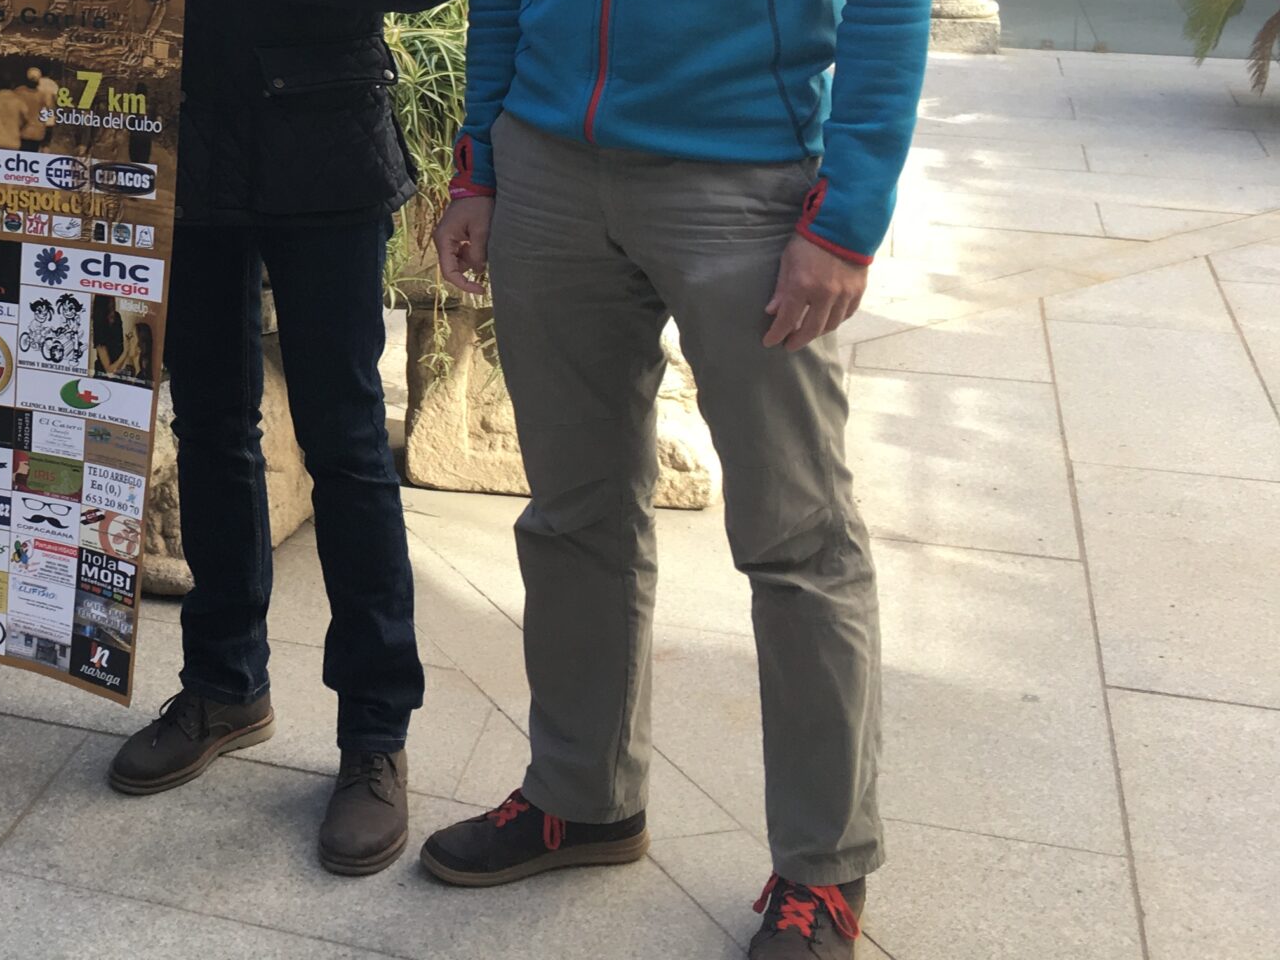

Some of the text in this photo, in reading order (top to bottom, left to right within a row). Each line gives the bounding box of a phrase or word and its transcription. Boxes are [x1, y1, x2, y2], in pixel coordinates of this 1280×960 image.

[57, 71, 146, 114] & 7 km
[56, 108, 100, 128] Subida
[103, 112, 124, 129] del
[125, 114, 163, 133] Cubo
[5, 153, 40, 173] chc
[95, 169, 151, 189] CIDACOS
[80, 253, 150, 283] chc
[79, 278, 149, 296] energía
[21, 401, 46, 410] CLINICA
[58, 407, 86, 416] MILAGRO
[88, 466, 142, 488] TE LO ARREGLO
[91, 479, 103, 490] En
[85, 493, 102, 505] 653
[104, 497, 115, 508] 20
[16, 523, 74, 540] COPACABANA
[82, 549, 117, 571] hola
[81, 564, 130, 590] MOBI
[80, 663, 121, 686] naroga
